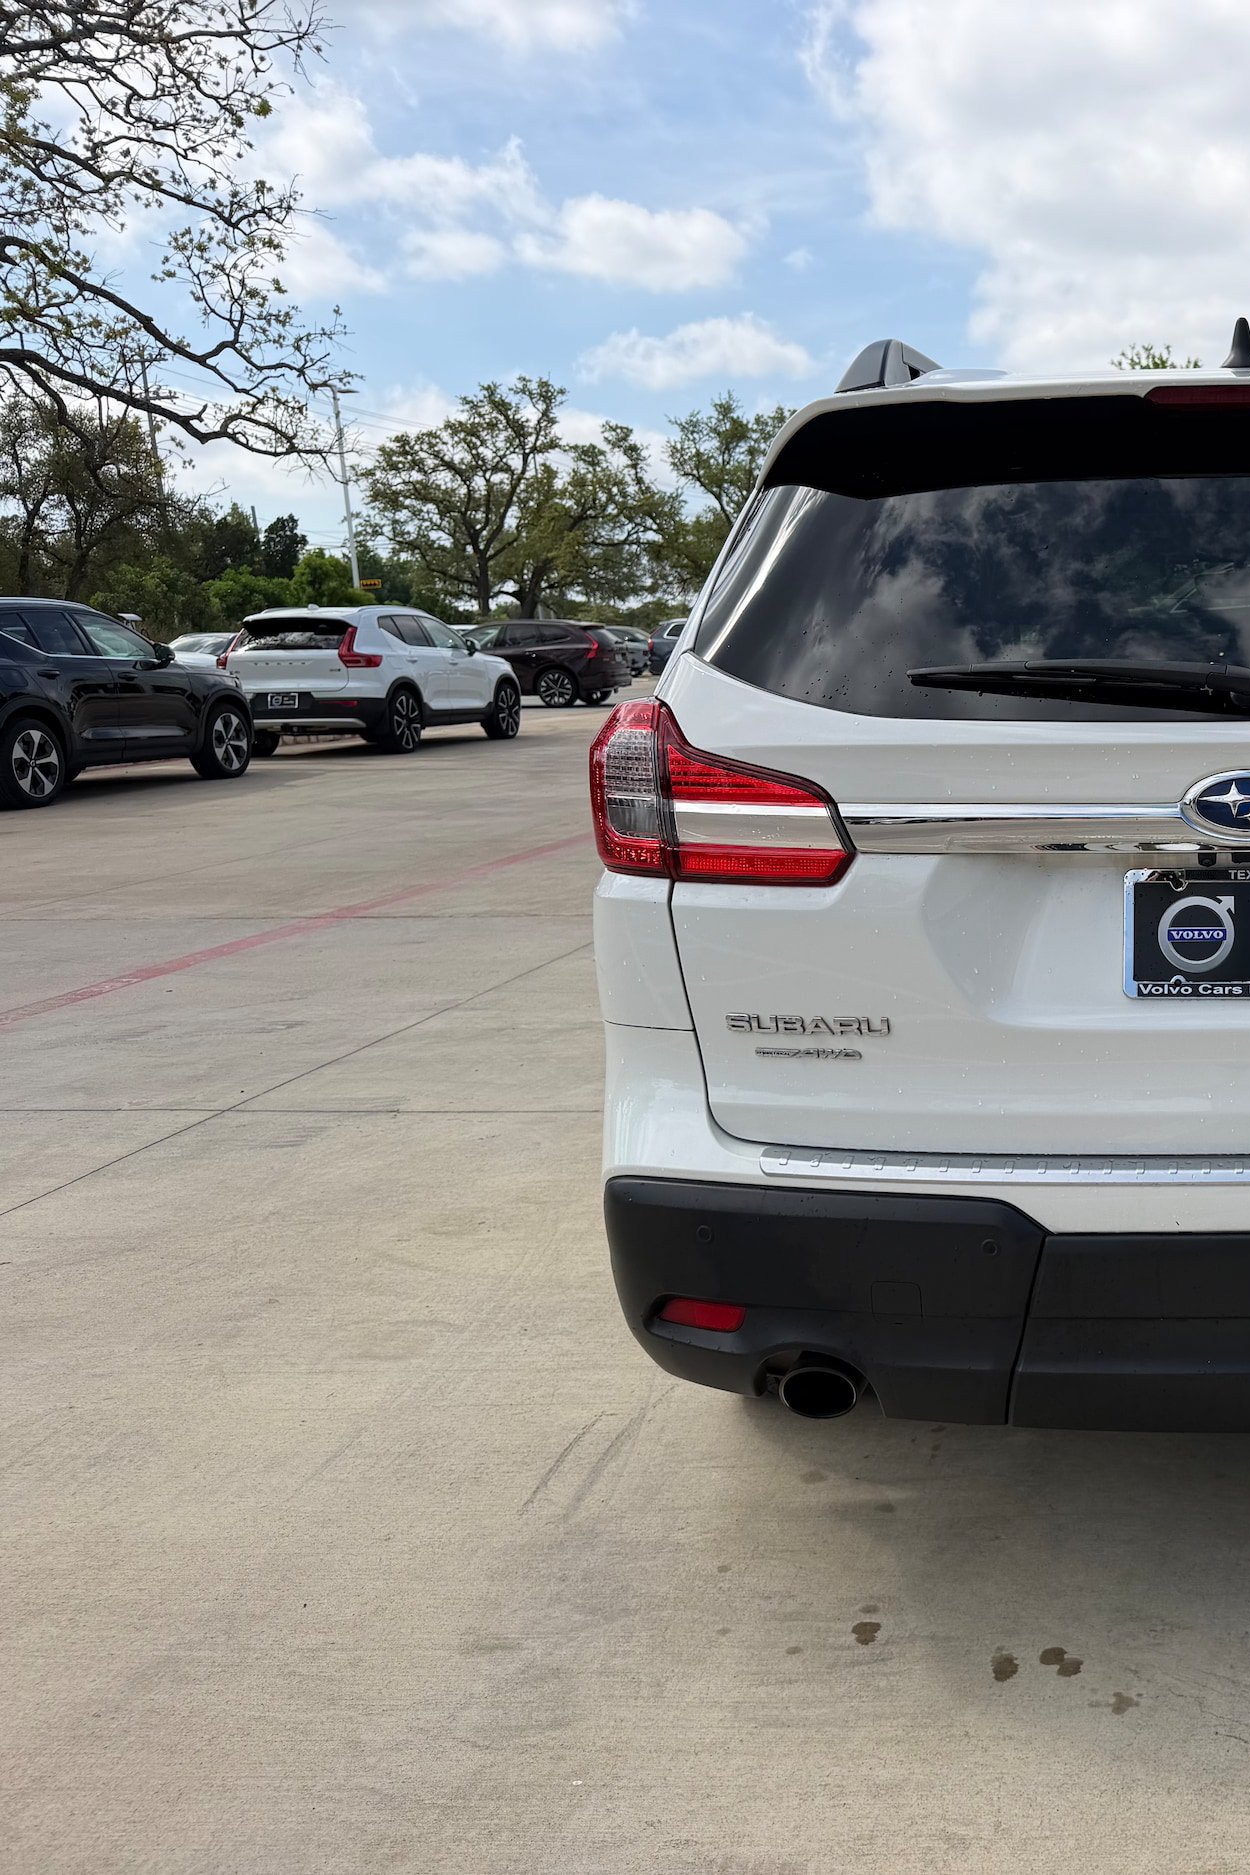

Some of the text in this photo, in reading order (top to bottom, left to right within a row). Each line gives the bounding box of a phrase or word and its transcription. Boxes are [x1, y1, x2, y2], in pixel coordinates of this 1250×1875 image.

[1170, 929, 1224, 940] VOLVO
[1138, 983, 1193, 995] Volvo
[1198, 983, 1243, 995] Cars
[725, 1012, 891, 1037] SUBARU
